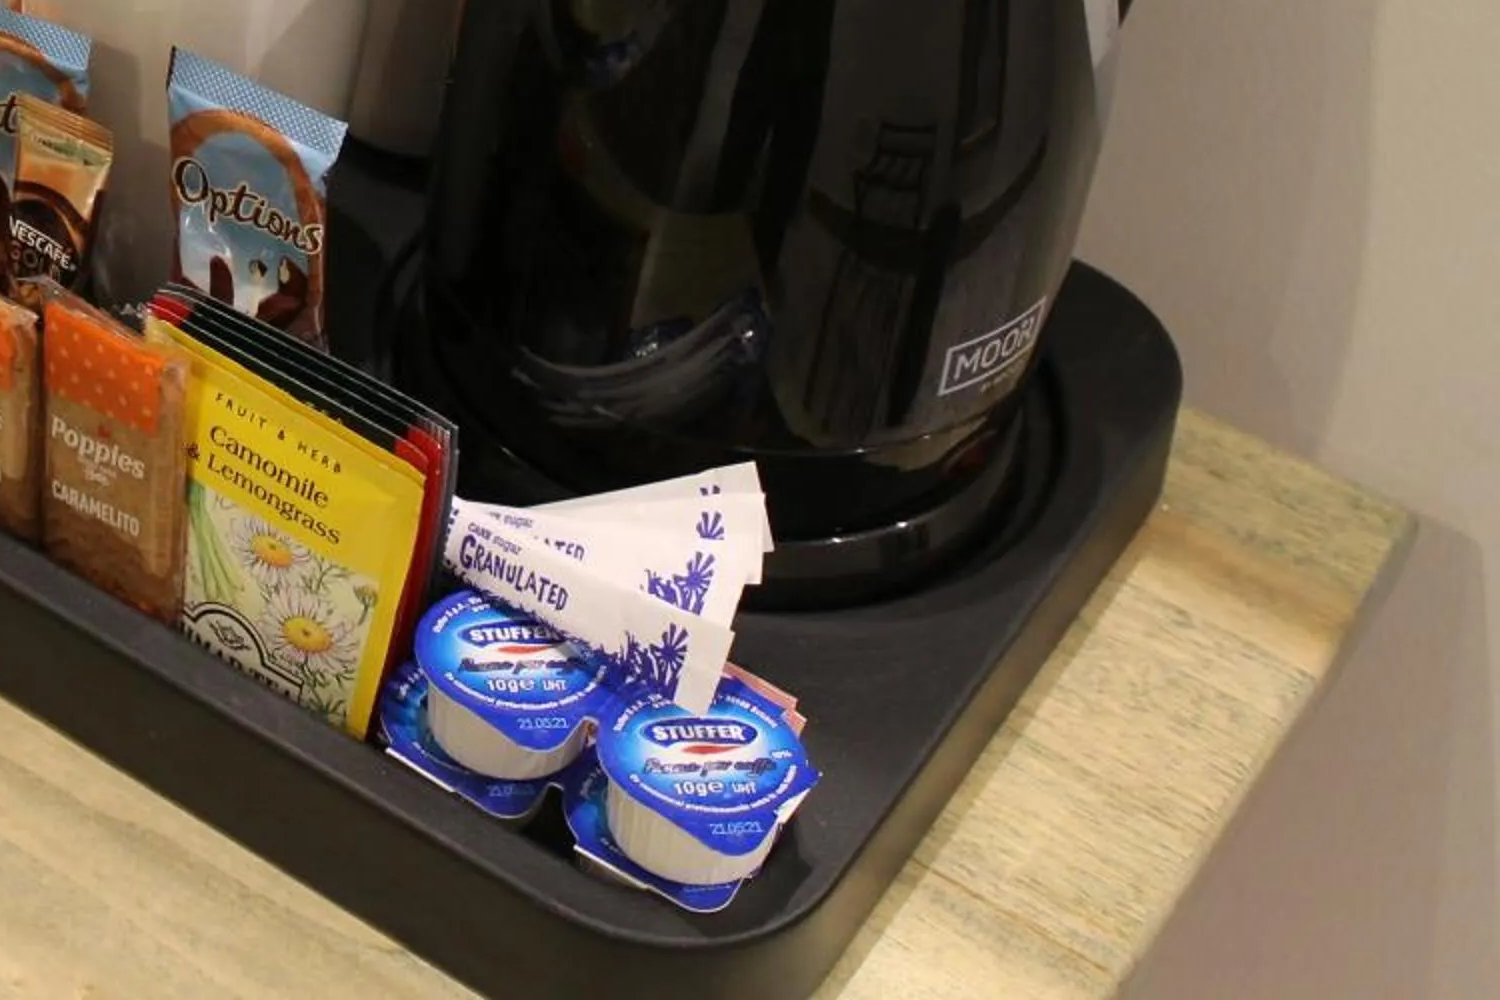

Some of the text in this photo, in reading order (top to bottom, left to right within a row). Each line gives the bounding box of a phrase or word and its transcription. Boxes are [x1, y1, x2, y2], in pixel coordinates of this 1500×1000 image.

[173, 157, 324, 253] Options
[209, 425, 329, 508] Camomile
[215, 392, 267, 428] FRUIT
[297, 440, 341, 473] HERB
[51, 480, 140, 536] CARAMELITO
[187, 443, 341, 545] & Lemongrass
[652, 724, 745, 741] STUFFER
